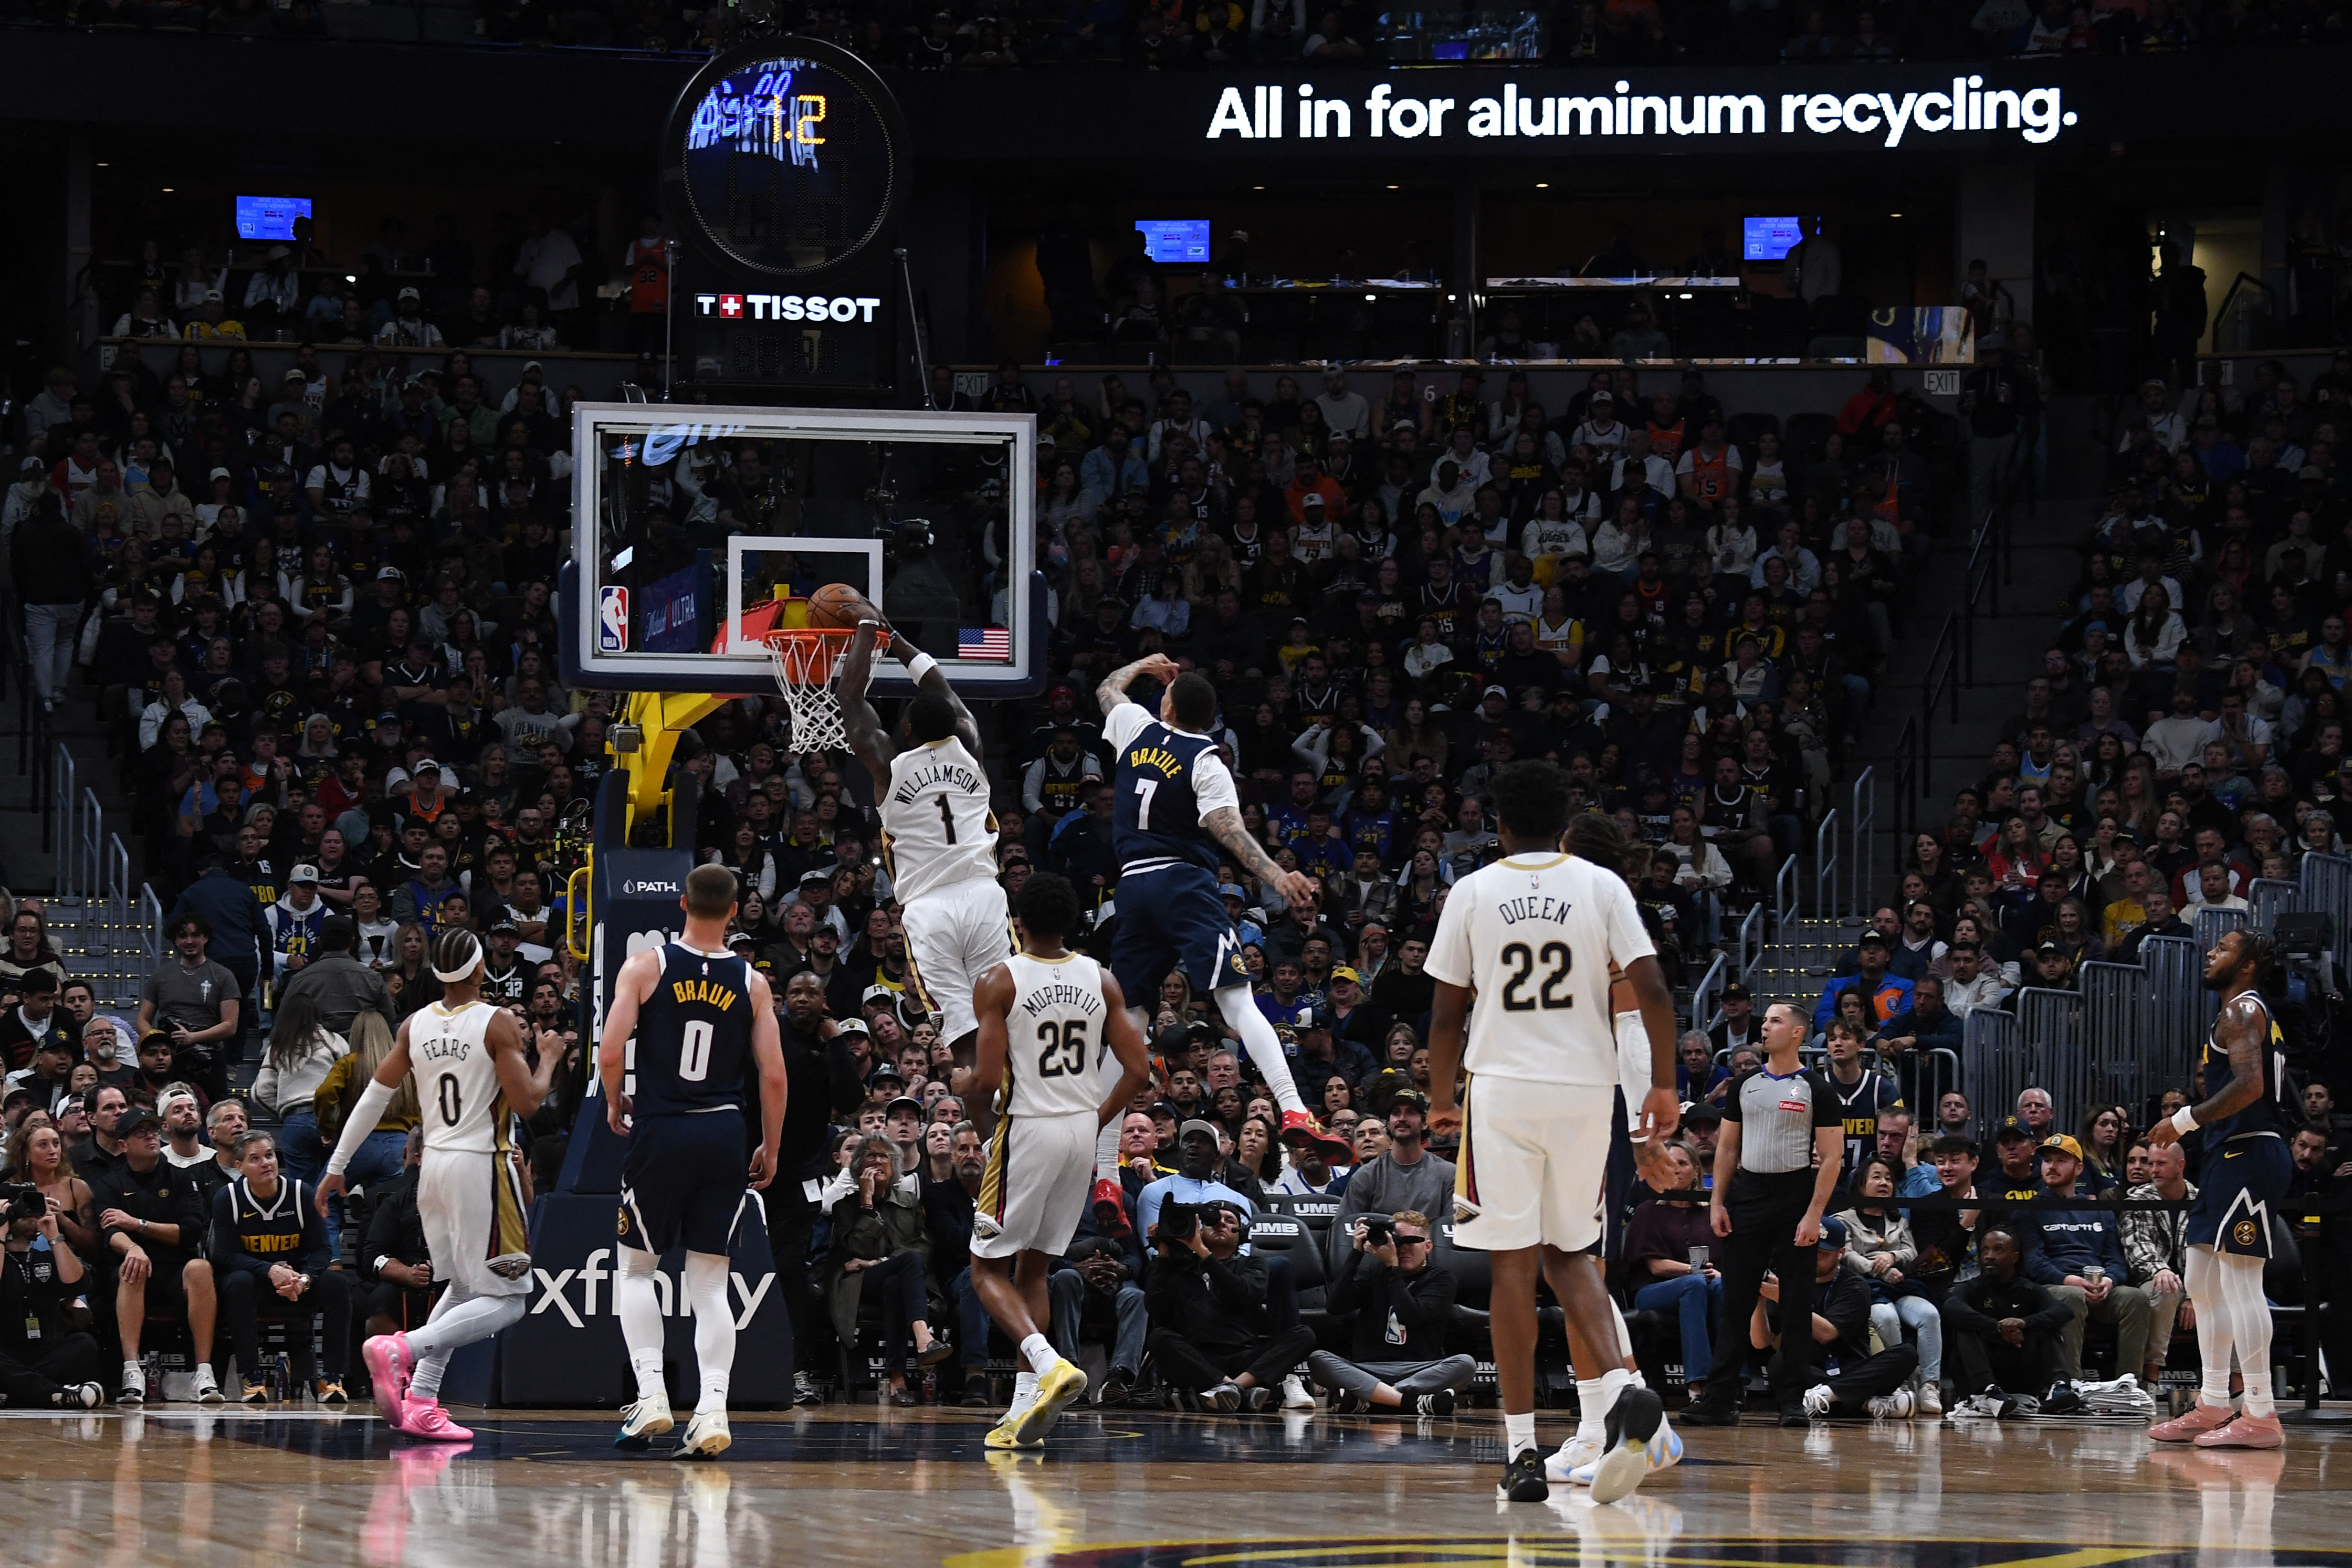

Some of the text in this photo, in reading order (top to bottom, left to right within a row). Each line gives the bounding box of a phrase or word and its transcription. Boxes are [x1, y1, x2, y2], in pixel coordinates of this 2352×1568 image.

[1206, 75, 2078, 148] All in for aluminum recycling.
[747, 294, 880, 323] TISSOT
[957, 375, 986, 394] EXIT
[1423, 385, 1435, 402] 6
[1927, 373, 1958, 394] EXIT
[1696, 480, 1718, 496] 15
[1196, 505, 1208, 519] 15
[672, 593, 696, 628] ULTRA
[1438, 618, 1455, 633] 15
[603, 636, 617, 647] NBA
[1130, 747, 1182, 780] BRAZILE
[894, 764, 981, 806] WILLIAMSON
[1134, 777, 1159, 830] 7
[934, 793, 957, 846] 1
[1735, 813, 1744, 828] 7
[257, 859, 272, 874] 15
[637, 881, 680, 892] PATH.
[1499, 896, 1572, 925] QUEEN
[1502, 941, 1573, 1011] 22
[505, 981, 523, 998] 32
[673, 979, 737, 1012] BRAUN
[1022, 983, 1101, 1019] MURPHY III
[422, 1037, 471, 1062] FEARS
[679, 1019, 714, 1082] 0
[1037, 1019, 1088, 1078] 25
[439, 1072, 462, 1127] 0
[1842, 1118, 1875, 1135] VER
[1294, 1203, 1340, 1214] UMB
[1251, 1222, 1300, 1233] UMB
[2043, 1223, 2093, 1232] carhartt
[241, 1233, 300, 1253] DENVER
[868, 1357, 919, 1366] UB
